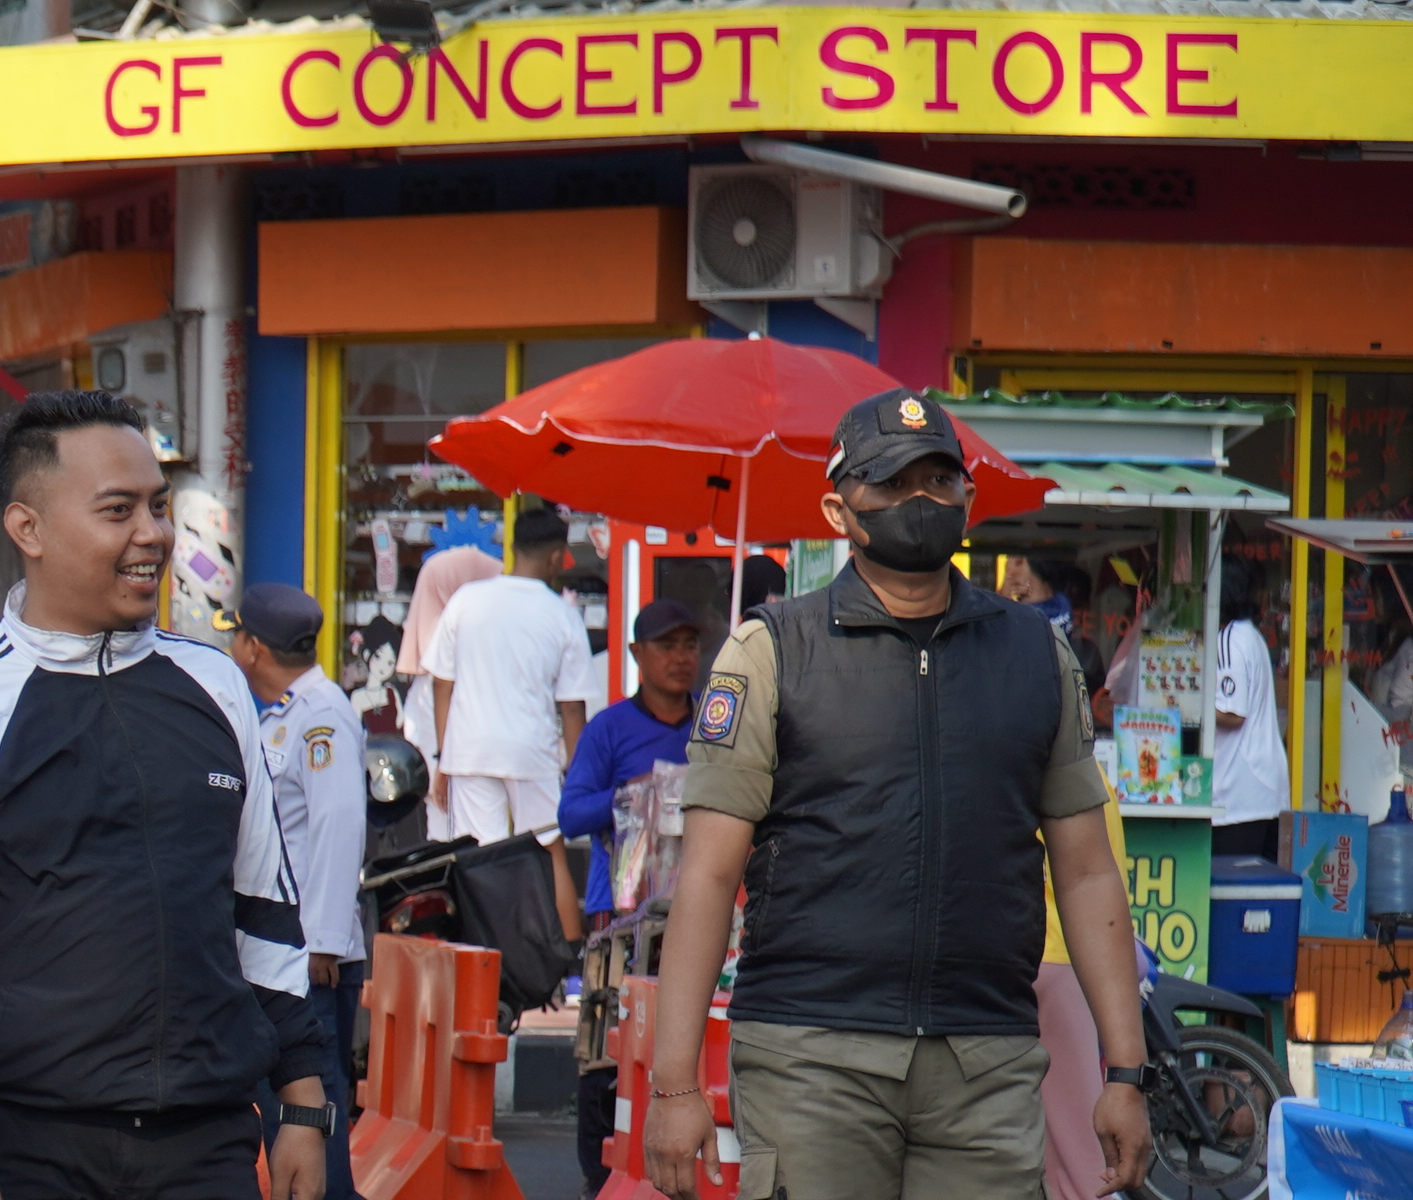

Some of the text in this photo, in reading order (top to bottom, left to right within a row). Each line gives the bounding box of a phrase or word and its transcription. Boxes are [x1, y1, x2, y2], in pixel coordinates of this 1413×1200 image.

[104, 26, 1238, 137] GF CONCEPT STORE
[1316, 864, 1334, 885] Le
[1331, 834, 1351, 913] Minerale
